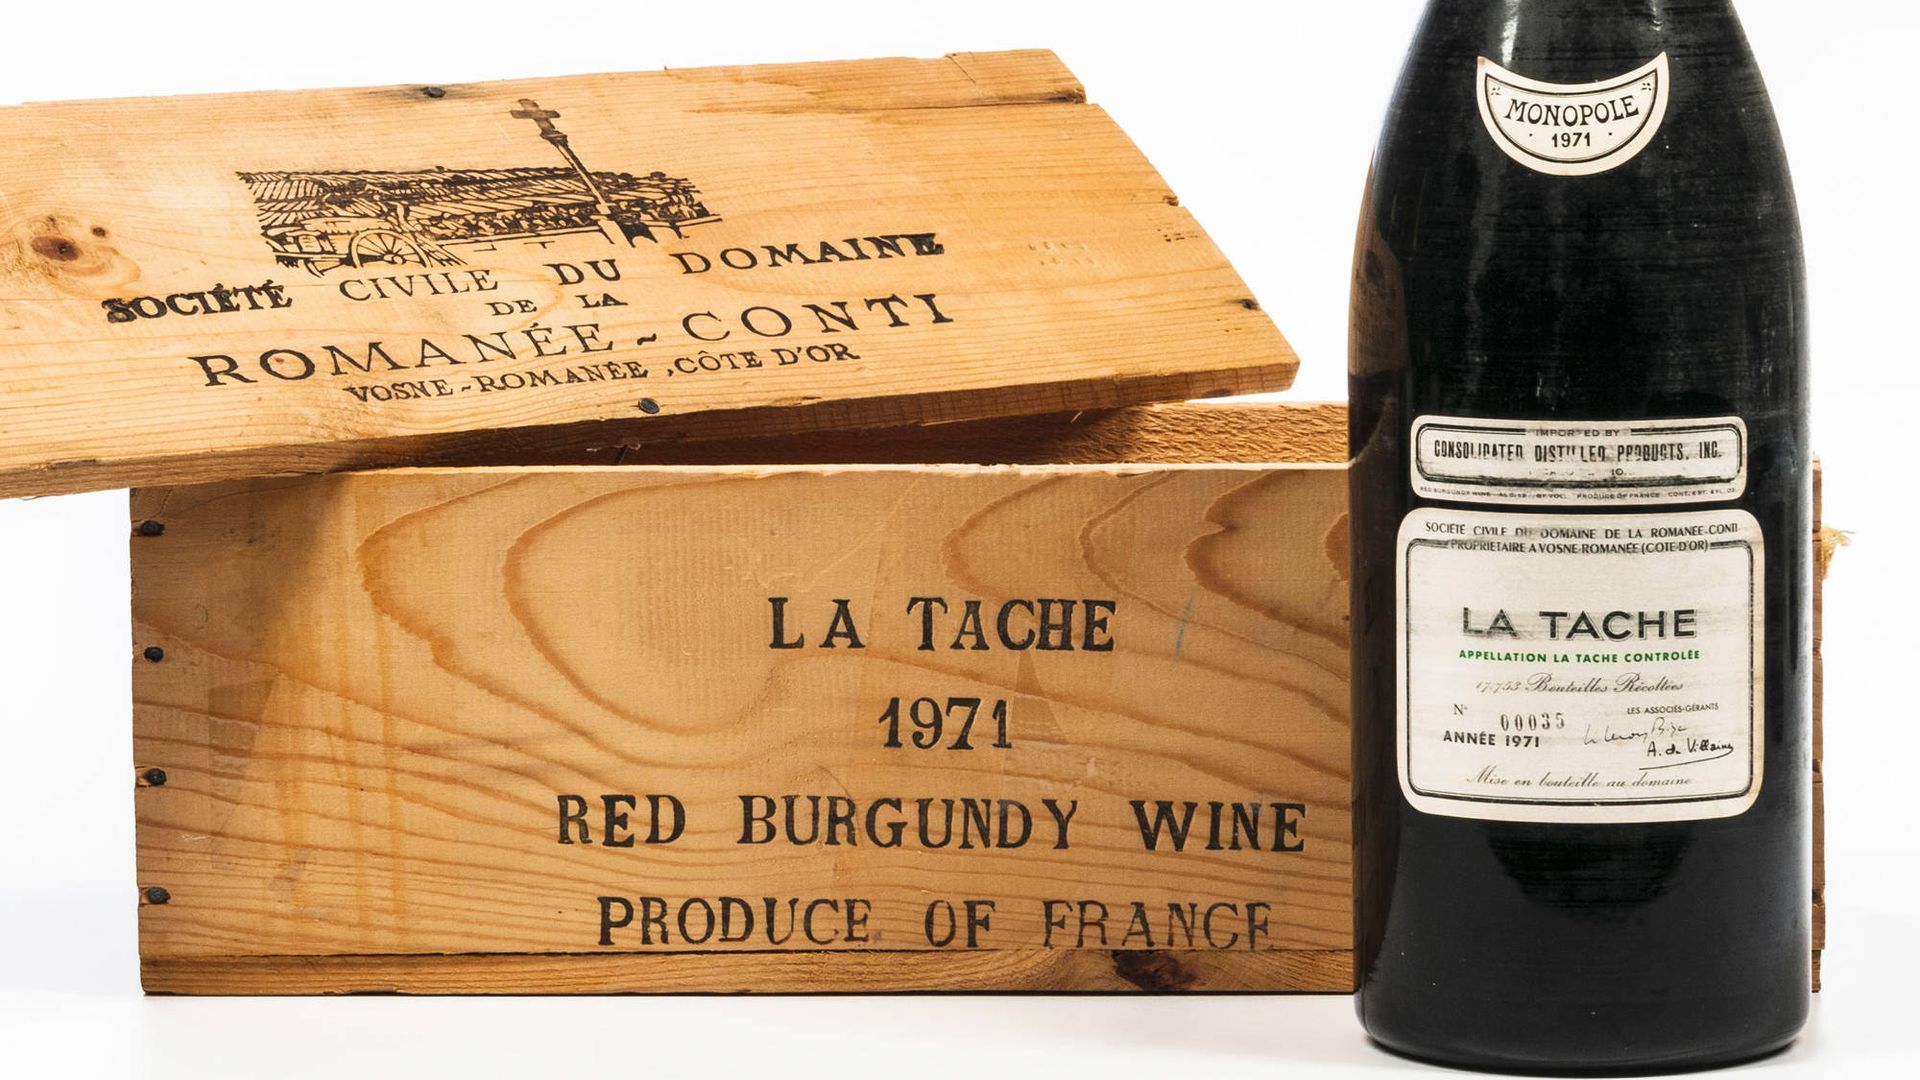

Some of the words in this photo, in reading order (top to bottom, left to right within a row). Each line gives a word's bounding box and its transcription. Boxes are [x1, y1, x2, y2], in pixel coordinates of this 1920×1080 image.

[1504, 95, 1639, 127] MONOPOLE
[1551, 132, 1591, 148] 1971
[101, 280, 293, 323] SOCIÉTÉ
[339, 269, 498, 302] CIVILE
[543, 258, 622, 286] DU
[670, 232, 945, 275] DOMAINE
[491, 299, 538, 316] DE
[582, 293, 629, 309] LA
[681, 293, 954, 342] CONTI
[777, 342, 860, 366] D'OR
[1605, 428, 1620, 437] BY
[1699, 441, 1722, 459] INC.
[1473, 526, 1507, 536] CIVILE
[1540, 527, 1596, 539] DOMAINE
[1605, 528, 1621, 539] DE
[1628, 528, 1642, 539] LA
[768, 597, 866, 652] LA
[908, 597, 1116, 653] TACHE
[1462, 607, 1518, 638] LA
[1539, 609, 1698, 640] TACHE
[1459, 650, 1547, 663] APPELLATION
[1553, 653, 1569, 663] LA
[1576, 653, 1618, 663] TACHE
[1624, 650, 1701, 663] CONTROLÉE
[1525, 671, 1608, 693] Bouteilles
[1500, 711, 1565, 731] 00035
[1627, 706, 1641, 714] LES
[878, 697, 1014, 750] 1971
[1443, 730, 1496, 746] ANNÉE
[1505, 735, 1540, 747] 1971
[1466, 765, 1509, 785] Mise
[1514, 778, 1532, 786] en
[1539, 772, 1600, 787] bouteille
[1606, 779, 1626, 787] au
[1632, 771, 1692, 787] domaine
[557, 794, 686, 848] RED
[737, 794, 1080, 852] BURGUNDY
[1131, 800, 1307, 854] WINE
[597, 896, 873, 947] PRODUCE
[923, 899, 997, 949] OF
[1042, 900, 1275, 951] FRANCE
